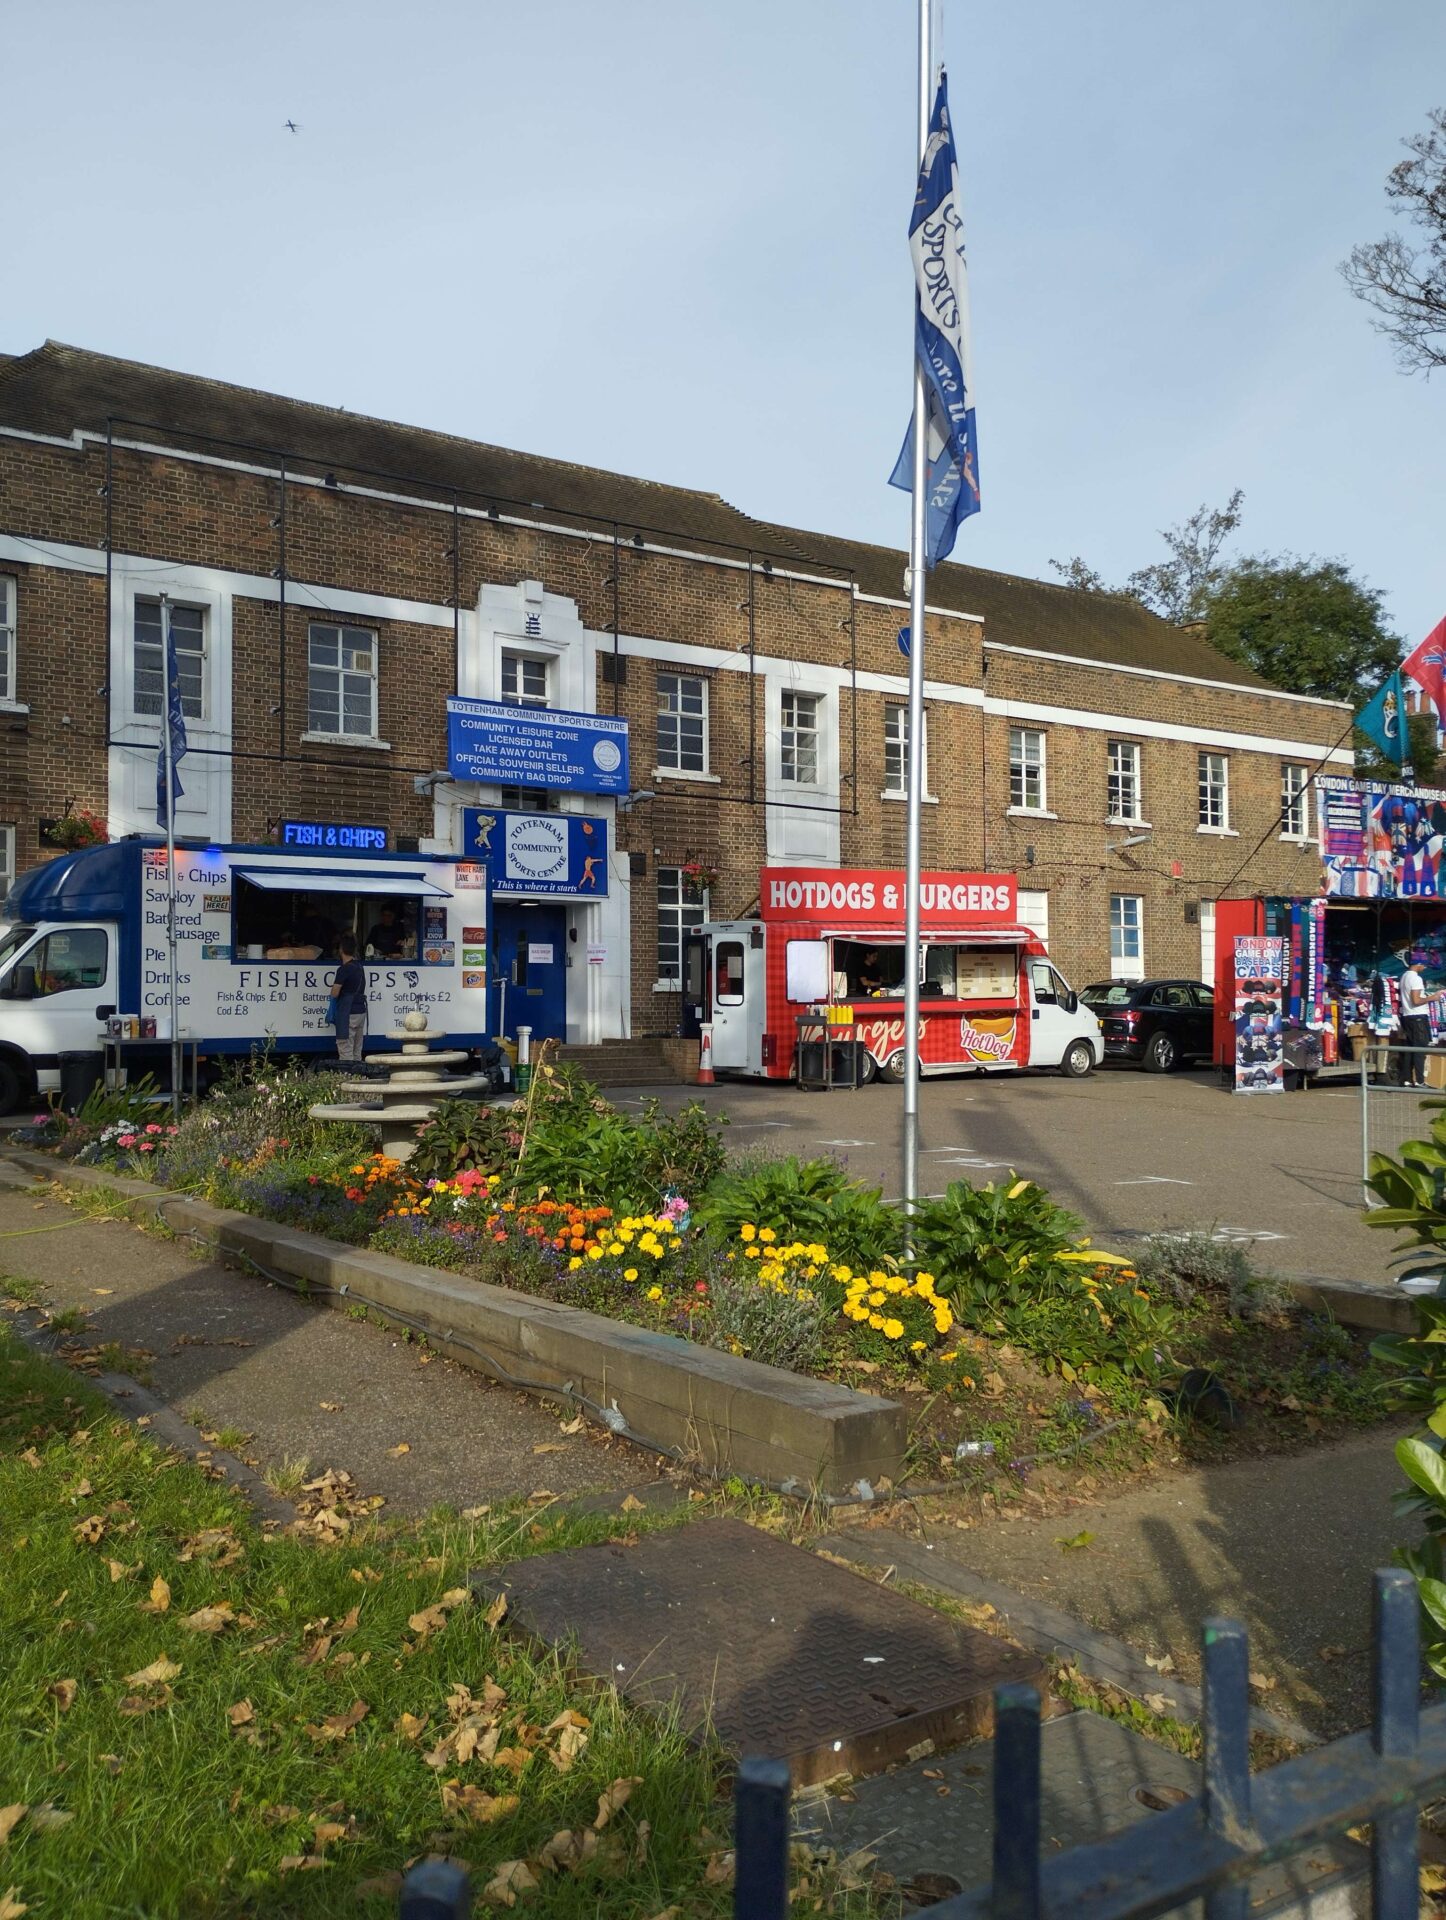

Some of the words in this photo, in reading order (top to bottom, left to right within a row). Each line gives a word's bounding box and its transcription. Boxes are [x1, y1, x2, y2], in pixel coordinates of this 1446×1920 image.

[922, 220, 961, 330] SPORTS
[451, 701, 505, 717] TOTTENHAM
[507, 708, 557, 725] COMMUNITY
[559, 716, 592, 730] SPORTS
[593, 720, 625, 732] CENTRE
[460, 719, 514, 735] COMMUNITY
[516, 725, 554, 738] LEISURE
[555, 730, 579, 742] ZONE
[488, 734, 533, 747] LICENSED
[534, 739, 553, 749] BAR
[473, 743, 498, 755] TAKE
[500, 747, 527, 758] AWAY
[528, 750, 568, 762] OUTLETS
[455, 753, 497, 767] OFFICIAL
[499, 757, 544, 771] SOUVENIR
[545, 763, 585, 775] SELLERS
[470, 766, 524, 780] COMMUNITY
[527, 771, 546, 782] BAG
[547, 774, 572, 784] DROP
[1314, 777, 1348, 791] LONDON
[1349, 780, 1372, 793] GAME
[1372, 782, 1387, 795] DAY
[285, 824, 323, 846] FISH
[326, 827, 337, 846] &
[340, 827, 386, 849] CHIPS
[510, 819, 564, 843] TOTTENHAM
[512, 843, 563, 854] COMMUNITY
[456, 865, 471, 873] WHITE
[473, 866, 486, 874] HART
[508, 852, 536, 878] SPORTS
[537, 855, 567, 878] CENTRE
[177, 872, 184, 882] &
[189, 868, 227, 886] Chips
[497, 880, 514, 889] This
[515, 881, 522, 890] is
[524, 882, 548, 891] where
[549, 883, 556, 891] it
[556, 884, 578, 894] starts
[769, 880, 876, 910] HOTDOGS
[882, 885, 899, 910] &
[206, 902, 229, 910] HERE!
[146, 911, 201, 926] Batered
[1235, 939, 1281, 949] LONDON
[145, 947, 166, 960] Pie
[1235, 949, 1262, 958] GAME
[1263, 949, 1281, 958] DAY
[1236, 957, 1281, 966] BASEBALL
[1236, 966, 1281, 978] CAPS
[145, 992, 191, 1006] Cofee
[217, 992, 235, 1002] Fish
[235, 990, 244, 1002] &
[245, 992, 266, 1004] Chips
[270, 990, 288, 1002] £10
[369, 990, 383, 1002] £4
[394, 993, 410, 1002] Soft
[438, 991, 451, 1002] £2
[217, 1006, 232, 1016] Cod
[235, 1004, 249, 1016] £8
[303, 1020, 314, 1029] Pie
[962, 1028, 1009, 1058] HotDog
